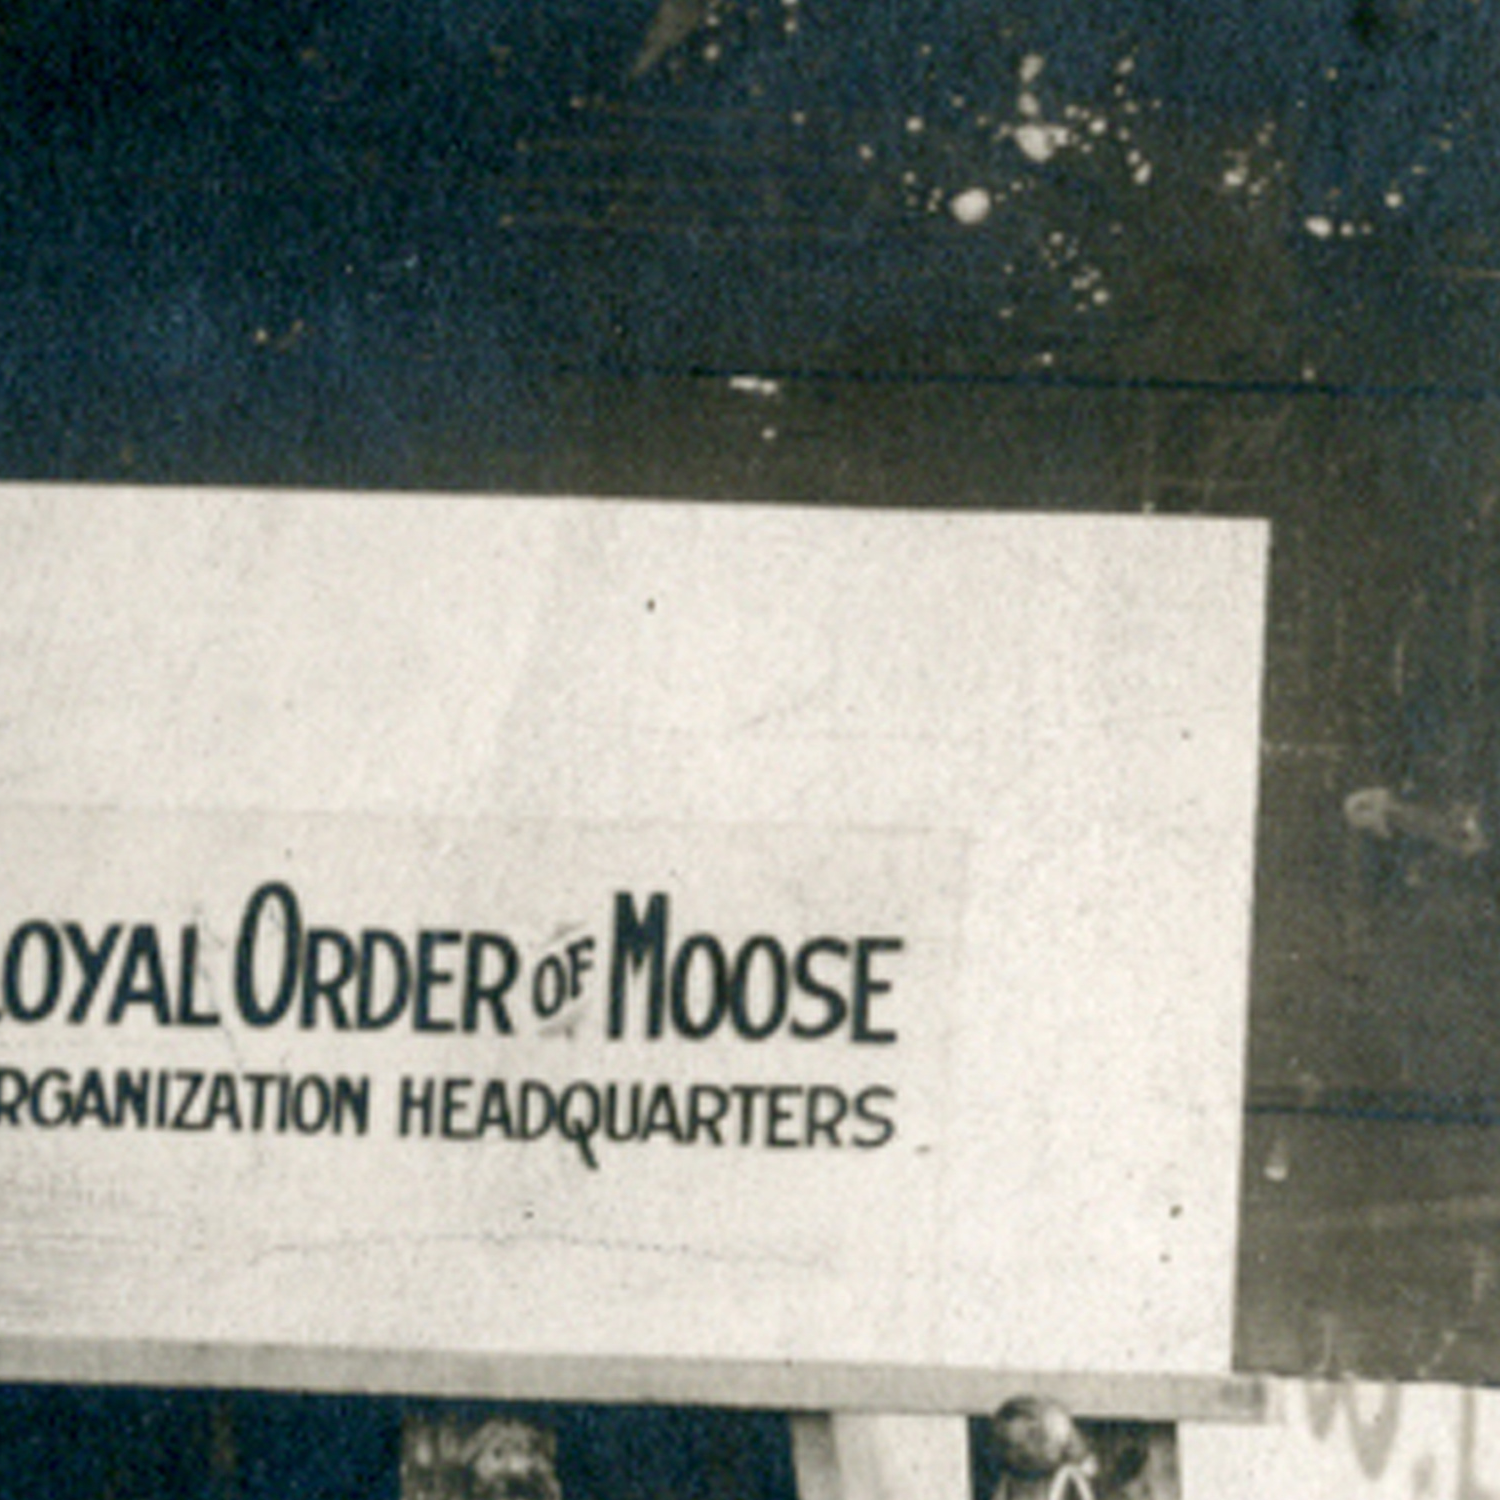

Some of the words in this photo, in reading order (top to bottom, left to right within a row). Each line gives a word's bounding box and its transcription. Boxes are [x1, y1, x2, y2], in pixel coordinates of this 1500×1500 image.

[235, 881, 520, 1035] ORDER
[532, 937, 595, 1019] OF
[606, 891, 904, 1044] MOOSE
[399, 1078, 894, 1170] HEADQUARTERS
